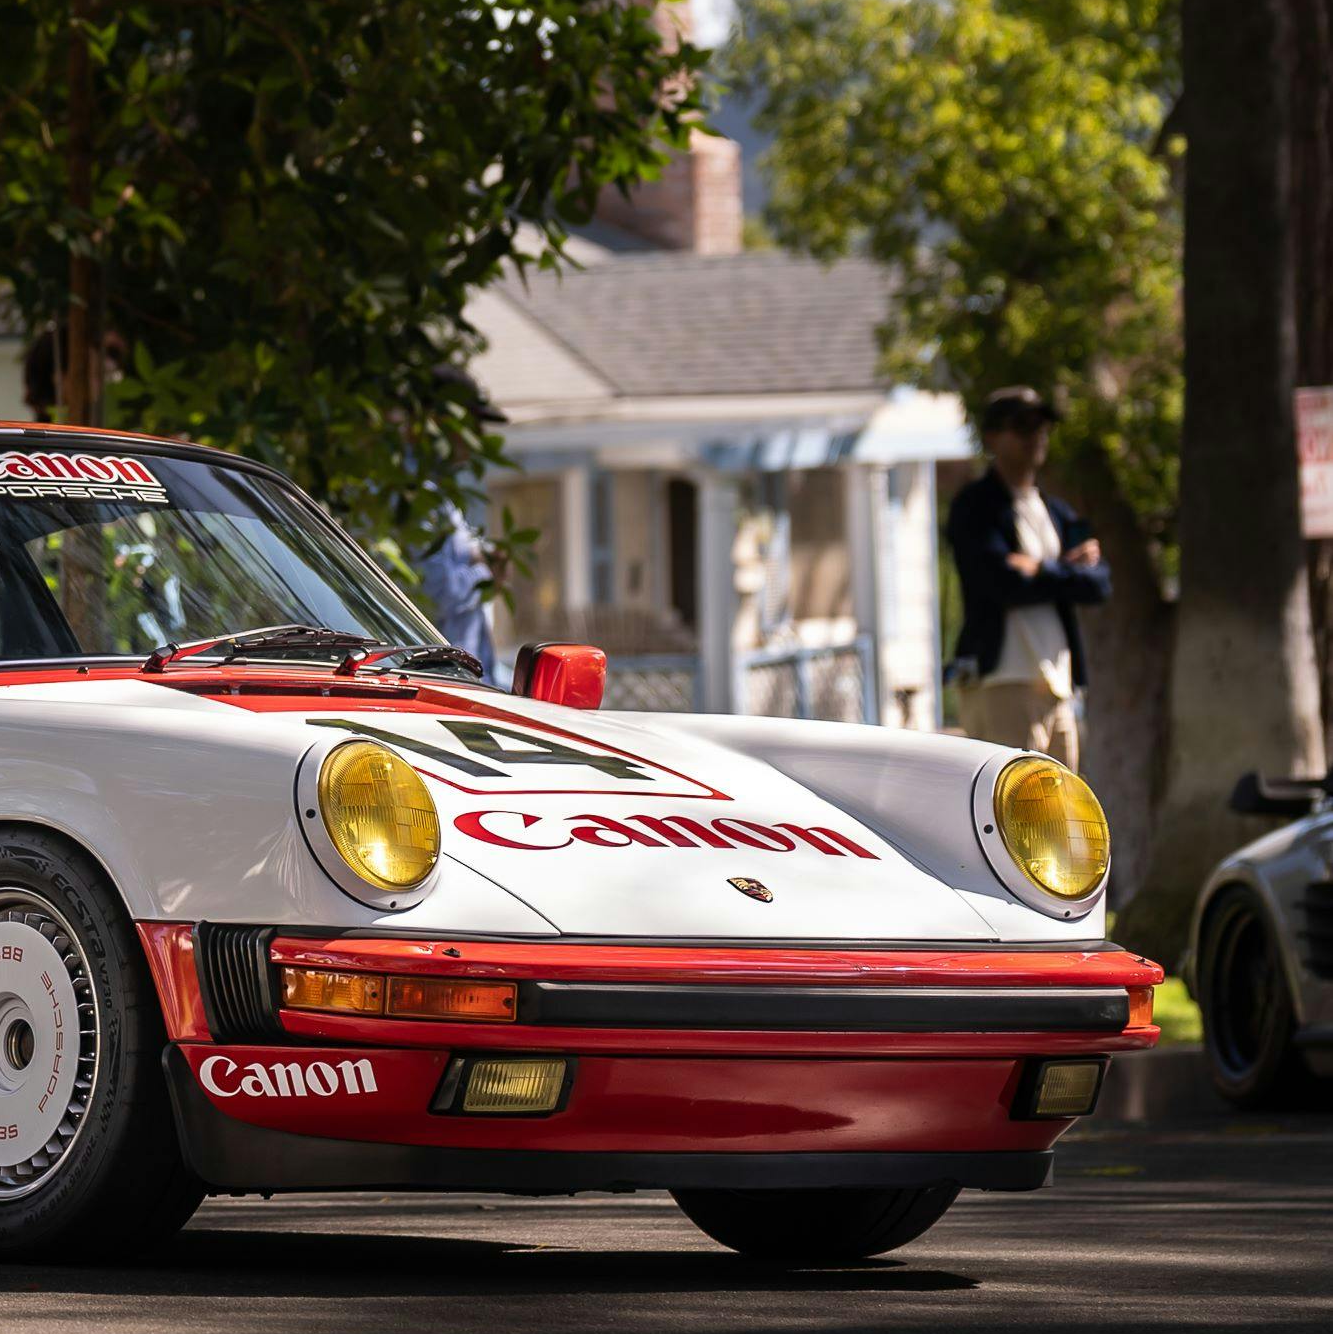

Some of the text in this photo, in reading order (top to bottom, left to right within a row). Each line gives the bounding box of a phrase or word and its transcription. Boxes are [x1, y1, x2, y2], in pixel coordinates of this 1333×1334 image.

[305, 718, 656, 781] 14
[454, 810, 881, 860] Canon
[38, 971, 64, 1113] PORSCHE
[199, 1055, 379, 1099] Canon
